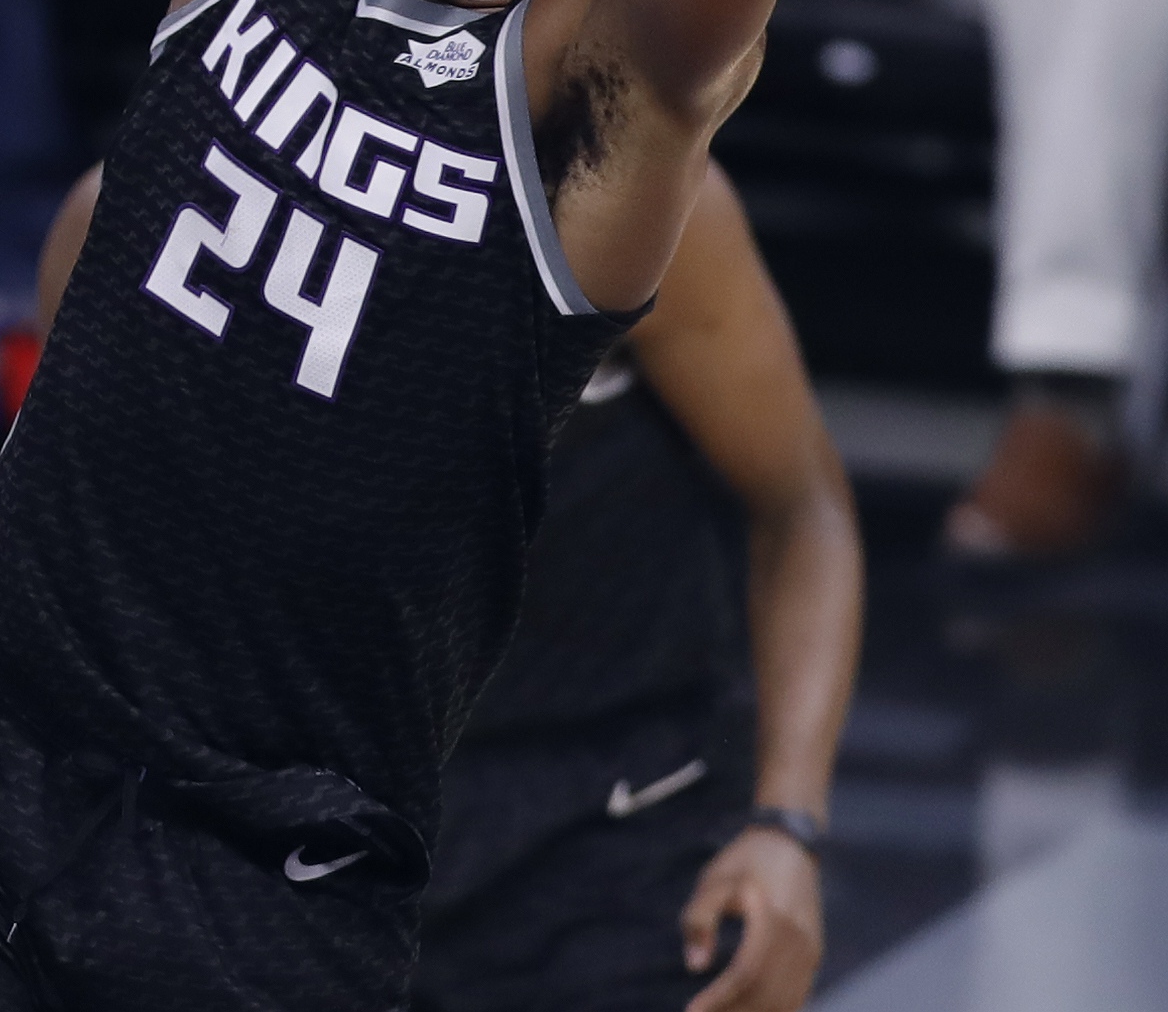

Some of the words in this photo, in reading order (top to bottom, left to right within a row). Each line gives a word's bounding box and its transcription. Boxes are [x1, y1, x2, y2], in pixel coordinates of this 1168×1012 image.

[426, 48, 474, 62] DIAMOND
[445, 41, 468, 53] BLUE
[399, 55, 477, 79] ALMONDS
[140, 138, 383, 401] 24
